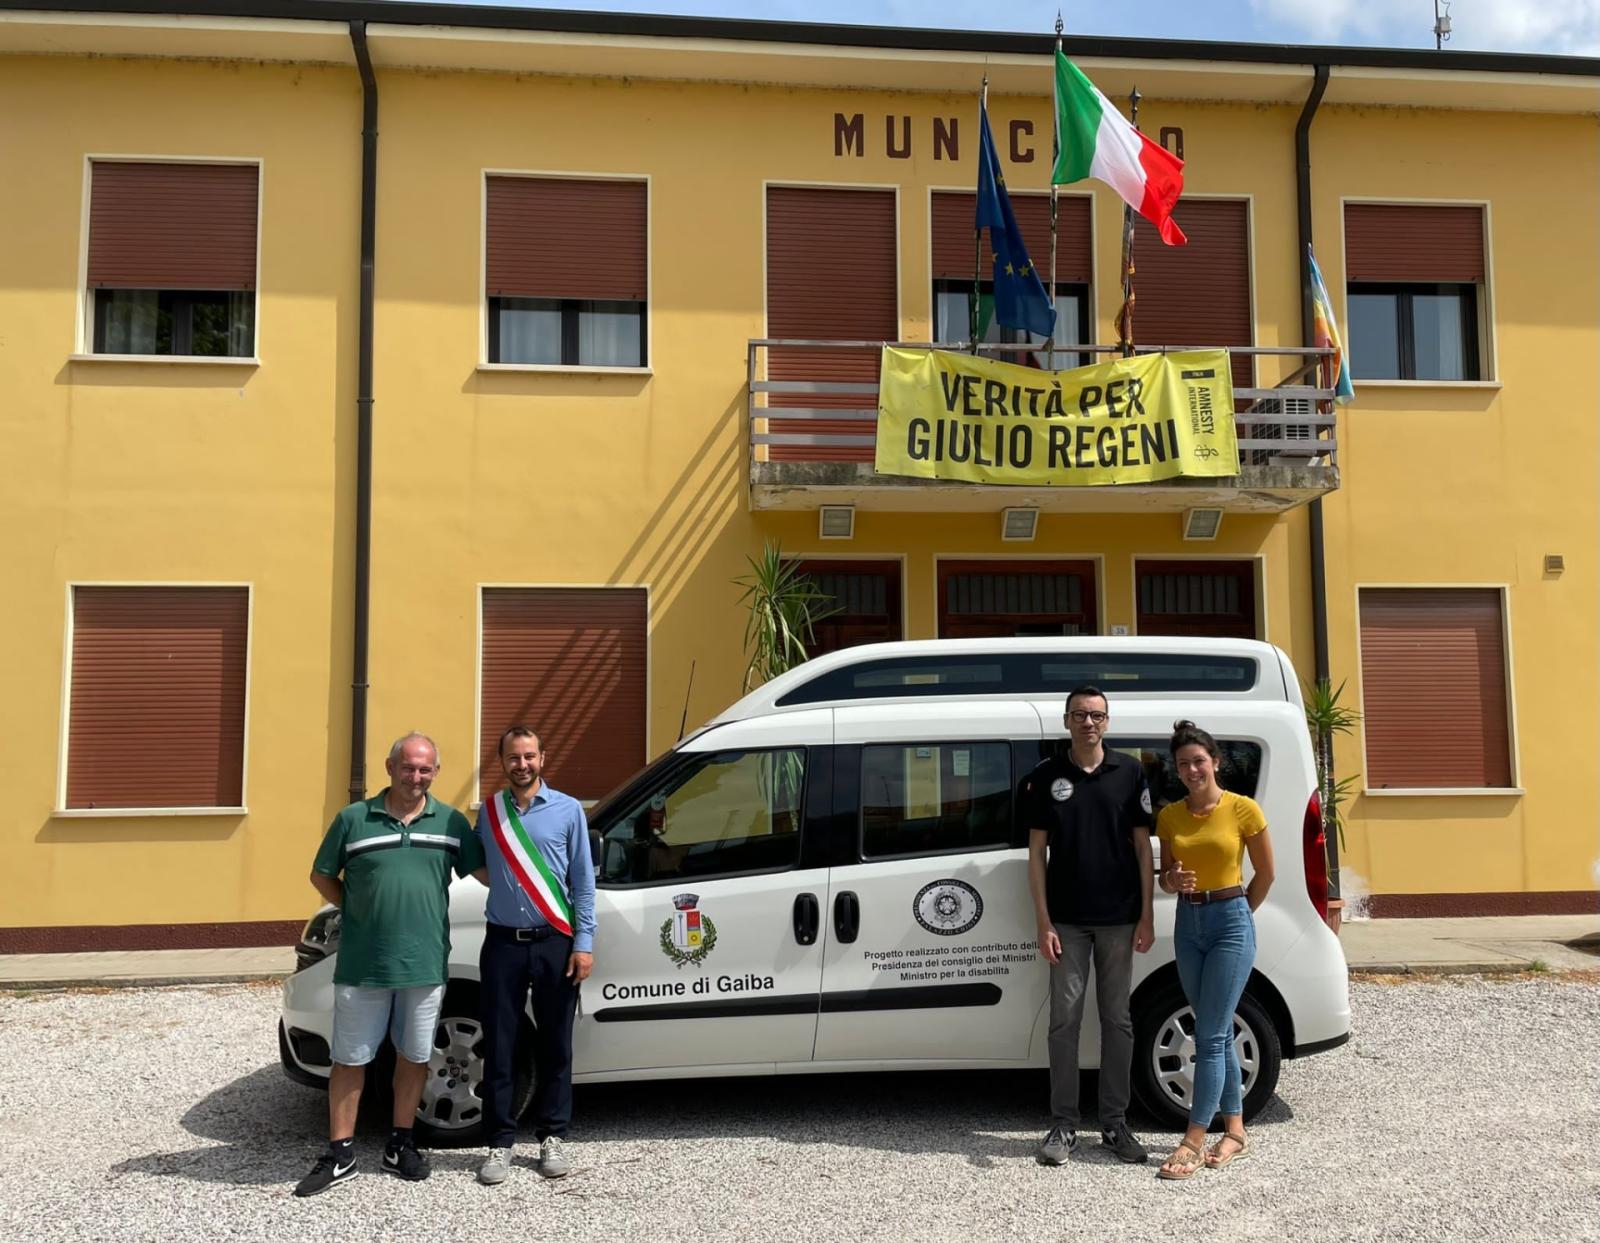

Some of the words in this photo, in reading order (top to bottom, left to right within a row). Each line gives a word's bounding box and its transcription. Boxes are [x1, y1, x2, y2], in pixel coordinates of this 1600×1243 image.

[834, 113, 1184, 166] MUNCO
[940, 371, 1068, 418] VERITÀ
[1078, 378, 1146, 418] PER
[1188, 386, 1201, 435] INTERNATIONAL
[1198, 386, 1215, 435] AMNESTY
[907, 417, 1033, 469] GIULIO
[1048, 418, 1180, 469] REGENI
[864, 951, 904, 961] Progetto
[906, 946, 950, 956] realizzato
[972, 943, 1018, 952] contributo
[1020, 942, 1040, 950] dell
[872, 959, 922, 971] Presidenza
[925, 959, 939, 967] del
[942, 955, 983, 967] consiglio
[986, 954, 1000, 963] dei
[1002, 953, 1036, 963] Ministri
[602, 982, 685, 1000] Comune
[692, 977, 710, 994] di
[717, 974, 774, 992] Gaiba
[900, 972, 937, 981] Ministro
[940, 973, 954, 981] per
